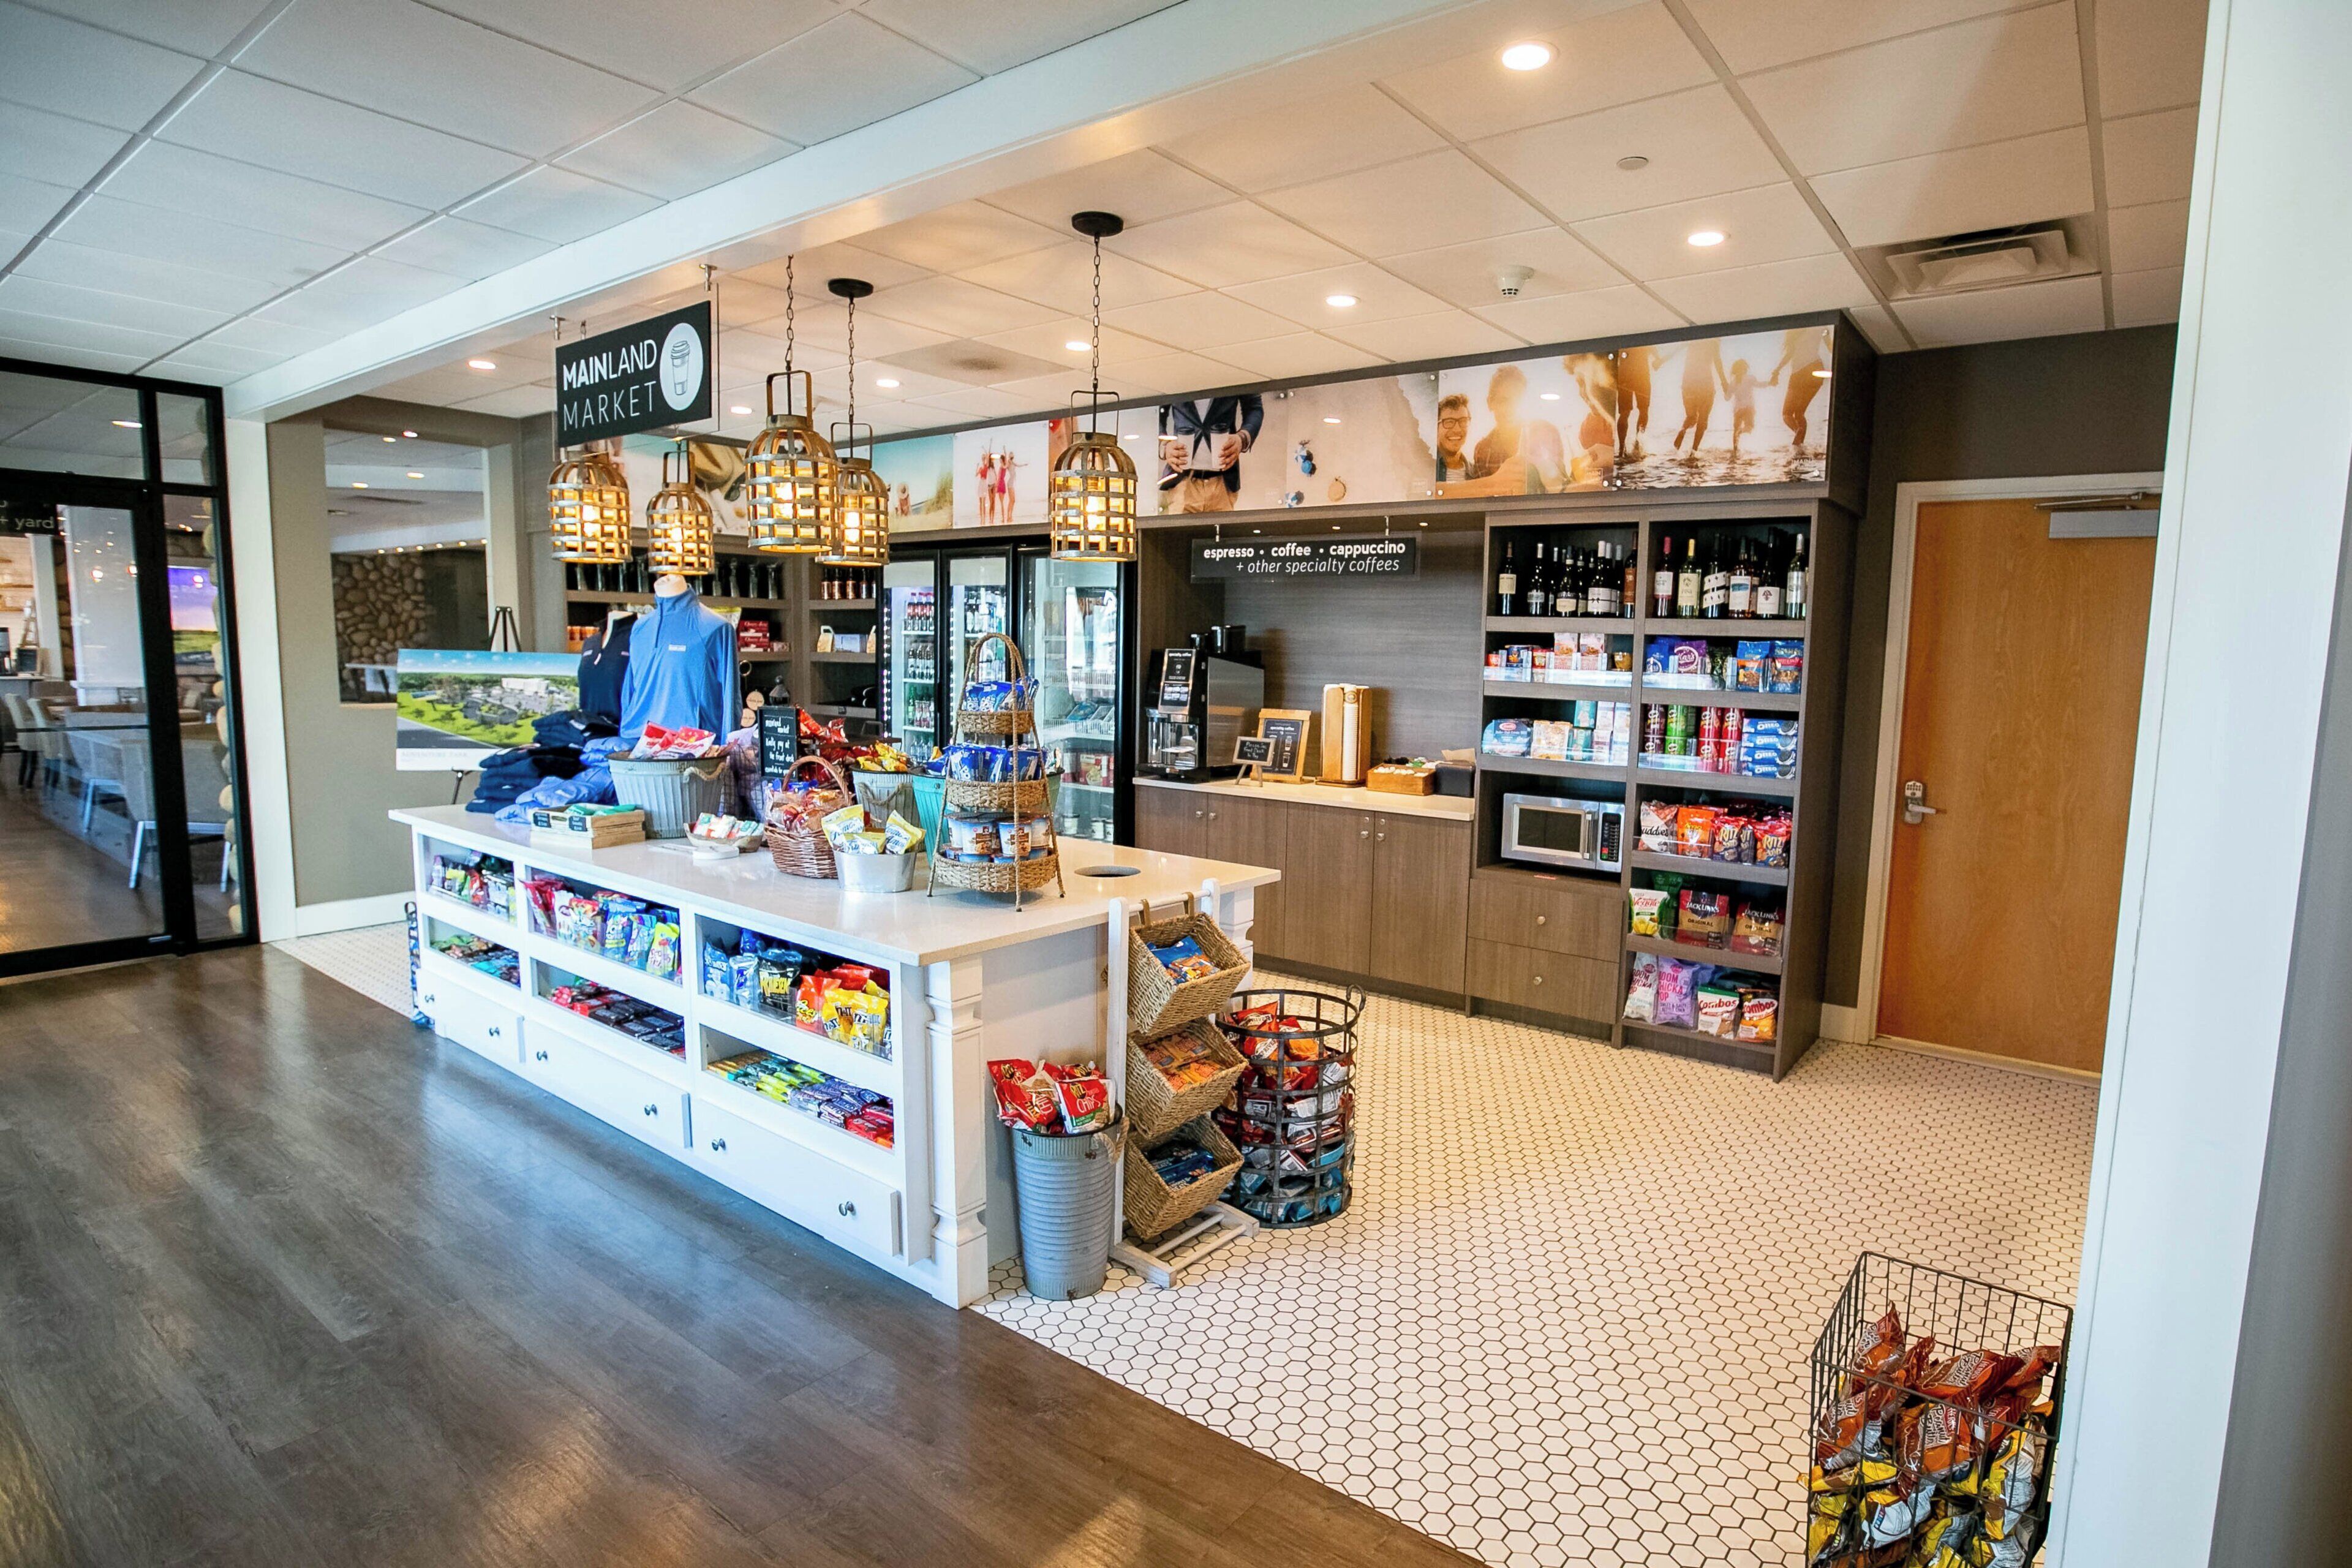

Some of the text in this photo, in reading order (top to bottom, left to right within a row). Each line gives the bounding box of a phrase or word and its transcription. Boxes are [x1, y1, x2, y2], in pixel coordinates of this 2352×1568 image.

[563, 339, 657, 391] MAINLAND
[564, 381, 657, 431] MARKET
[15, 516, 55, 530] yard
[1204, 540, 1406, 561] espresso coffee cappuccino
[1248, 559, 1282, 573] other
[1285, 557, 1345, 575] specialty
[1349, 557, 1400, 573] coffees
[1757, 722, 1780, 731] OREO
[1755, 737, 1779, 745] OREO
[1754, 752, 1777, 760] OREO
[1719, 827, 1740, 842] RITZ
[1762, 834, 1785, 850] RITZ
[1686, 902, 1701, 910] JACK
[1744, 909, 1779, 920] JACK LINK'S
[1687, 918, 1714, 927] ORIGINAL
[1070, 1084, 1086, 1099] RITZ
[1076, 1094, 1101, 1113] CHIPS
[1936, 1403, 1952, 1445] Peanut
